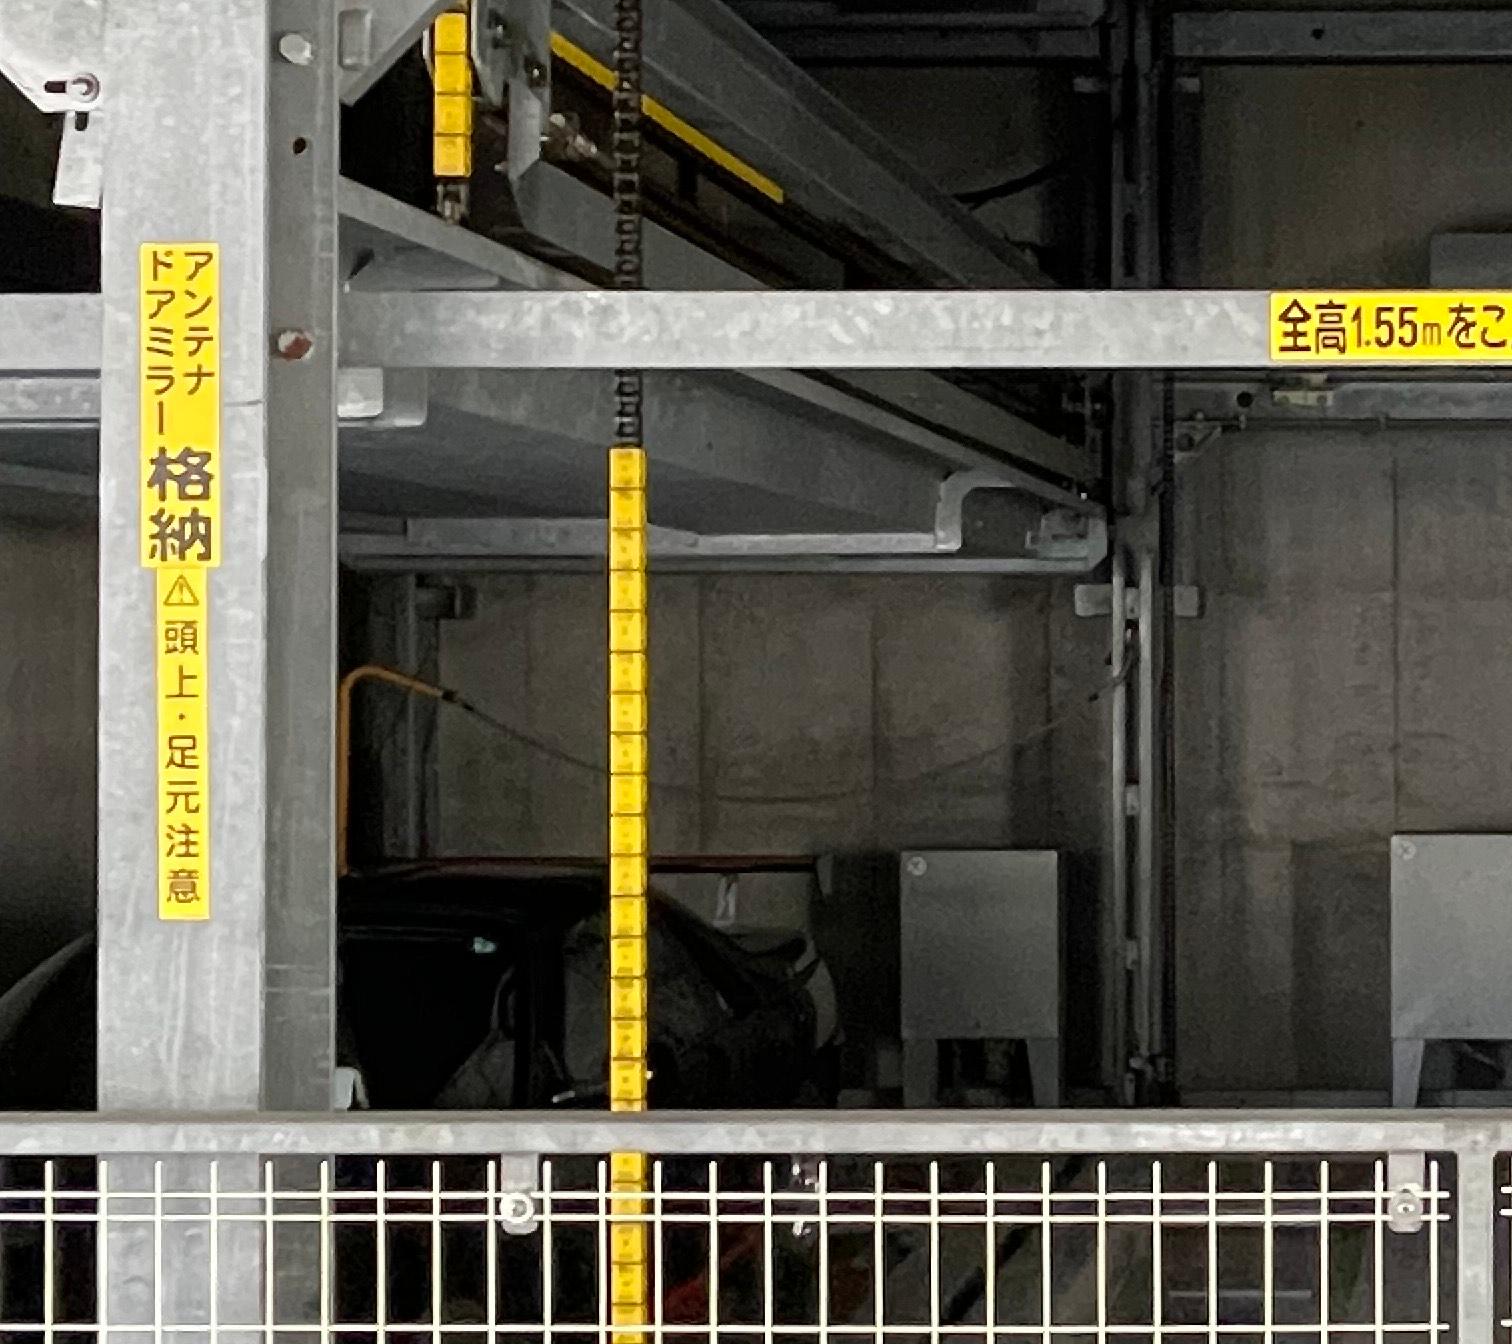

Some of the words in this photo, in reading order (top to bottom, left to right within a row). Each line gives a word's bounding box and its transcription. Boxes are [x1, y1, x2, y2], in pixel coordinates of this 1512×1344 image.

[146, 251, 176, 435] ドアミラー
[183, 252, 215, 396] アンテナ
[146, 446, 215, 561] 格納
[164, 619, 200, 904] 頭上・足元注意
